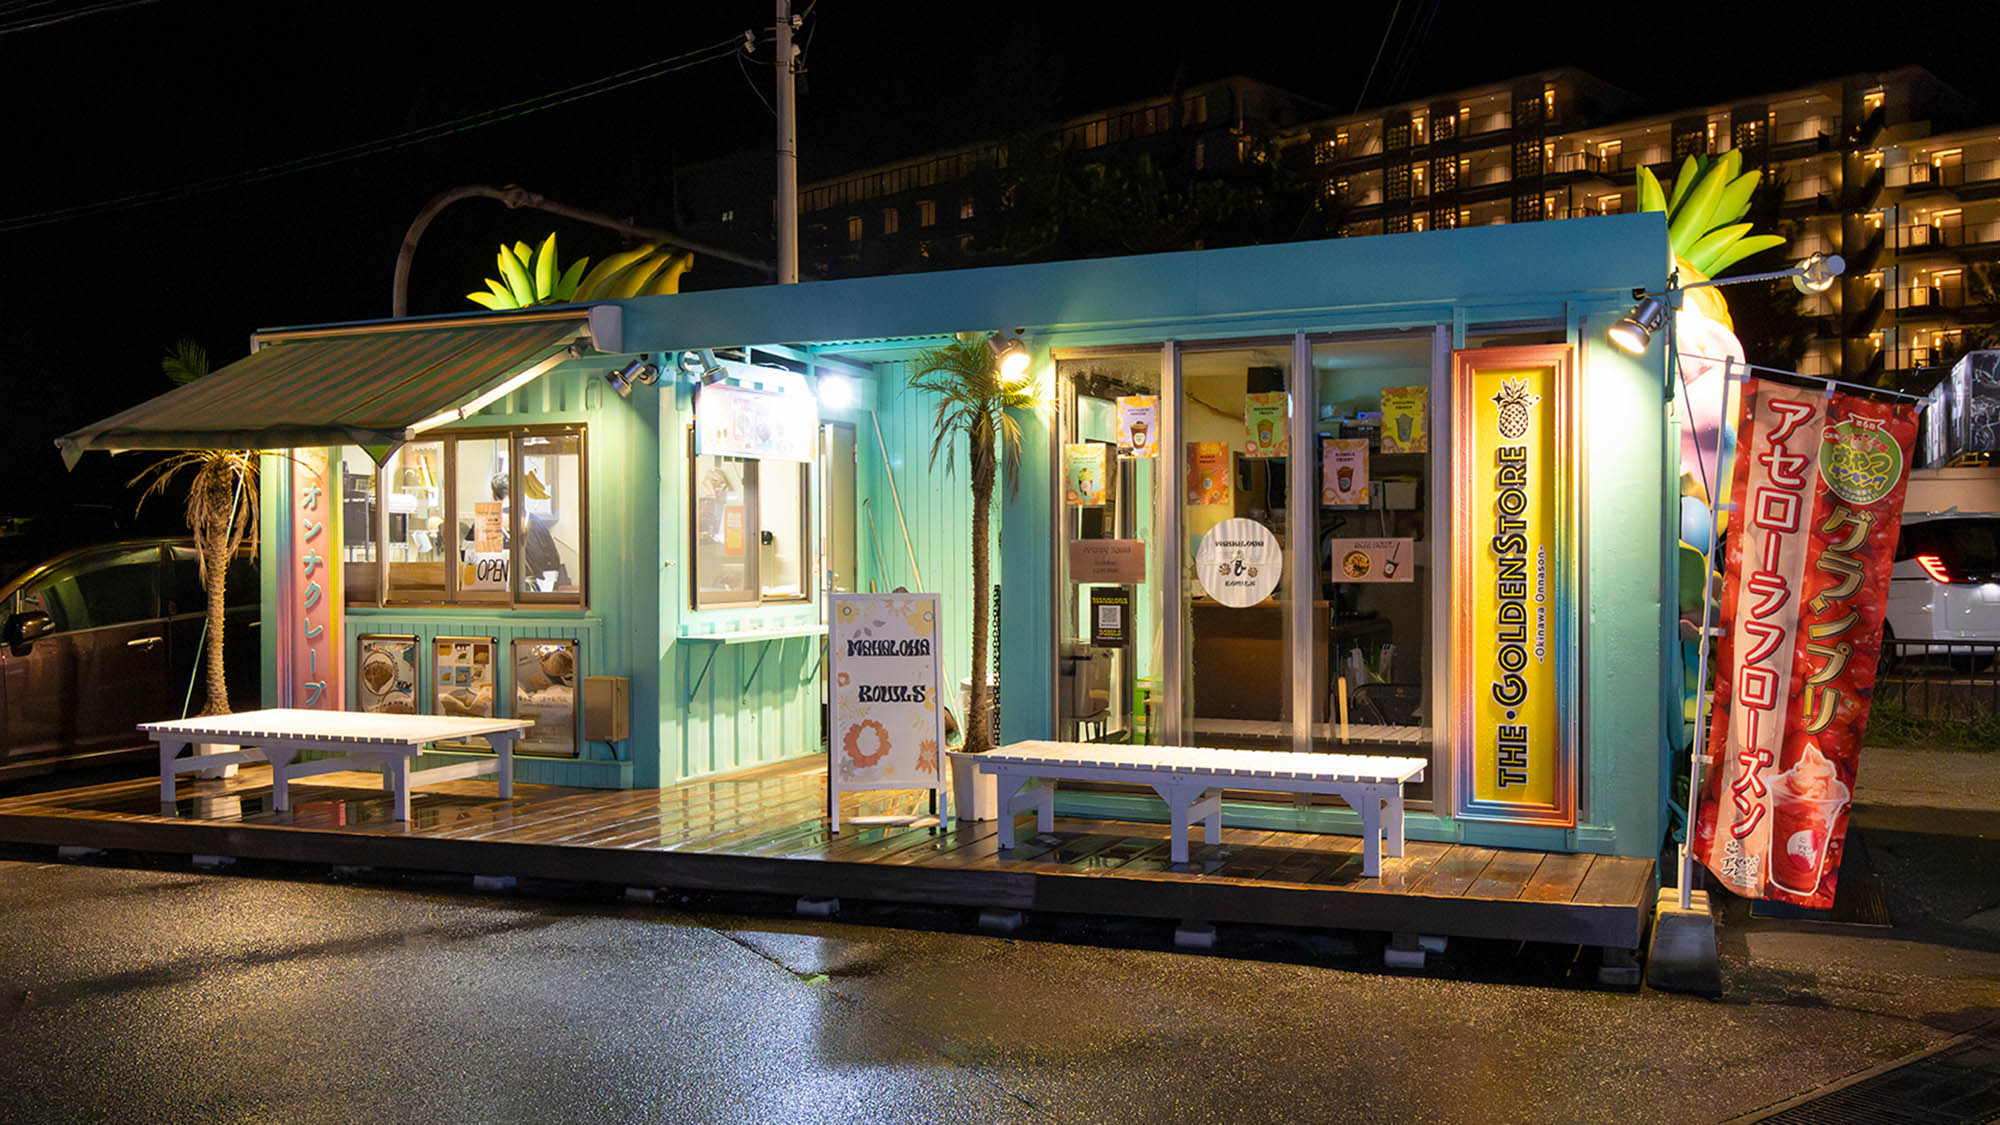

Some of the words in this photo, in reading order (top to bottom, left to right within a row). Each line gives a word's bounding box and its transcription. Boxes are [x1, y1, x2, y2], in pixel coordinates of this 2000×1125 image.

[301, 483, 326, 706] オンナクレープ
[477, 559, 509, 582] OPEN
[847, 638, 931, 657] MAHALOHA
[1731, 399, 1815, 839] アセローラフローズン
[1803, 505, 1877, 735] グランプリ
[859, 684, 926, 703] BOWLS
[1498, 725, 1528, 788] THE
